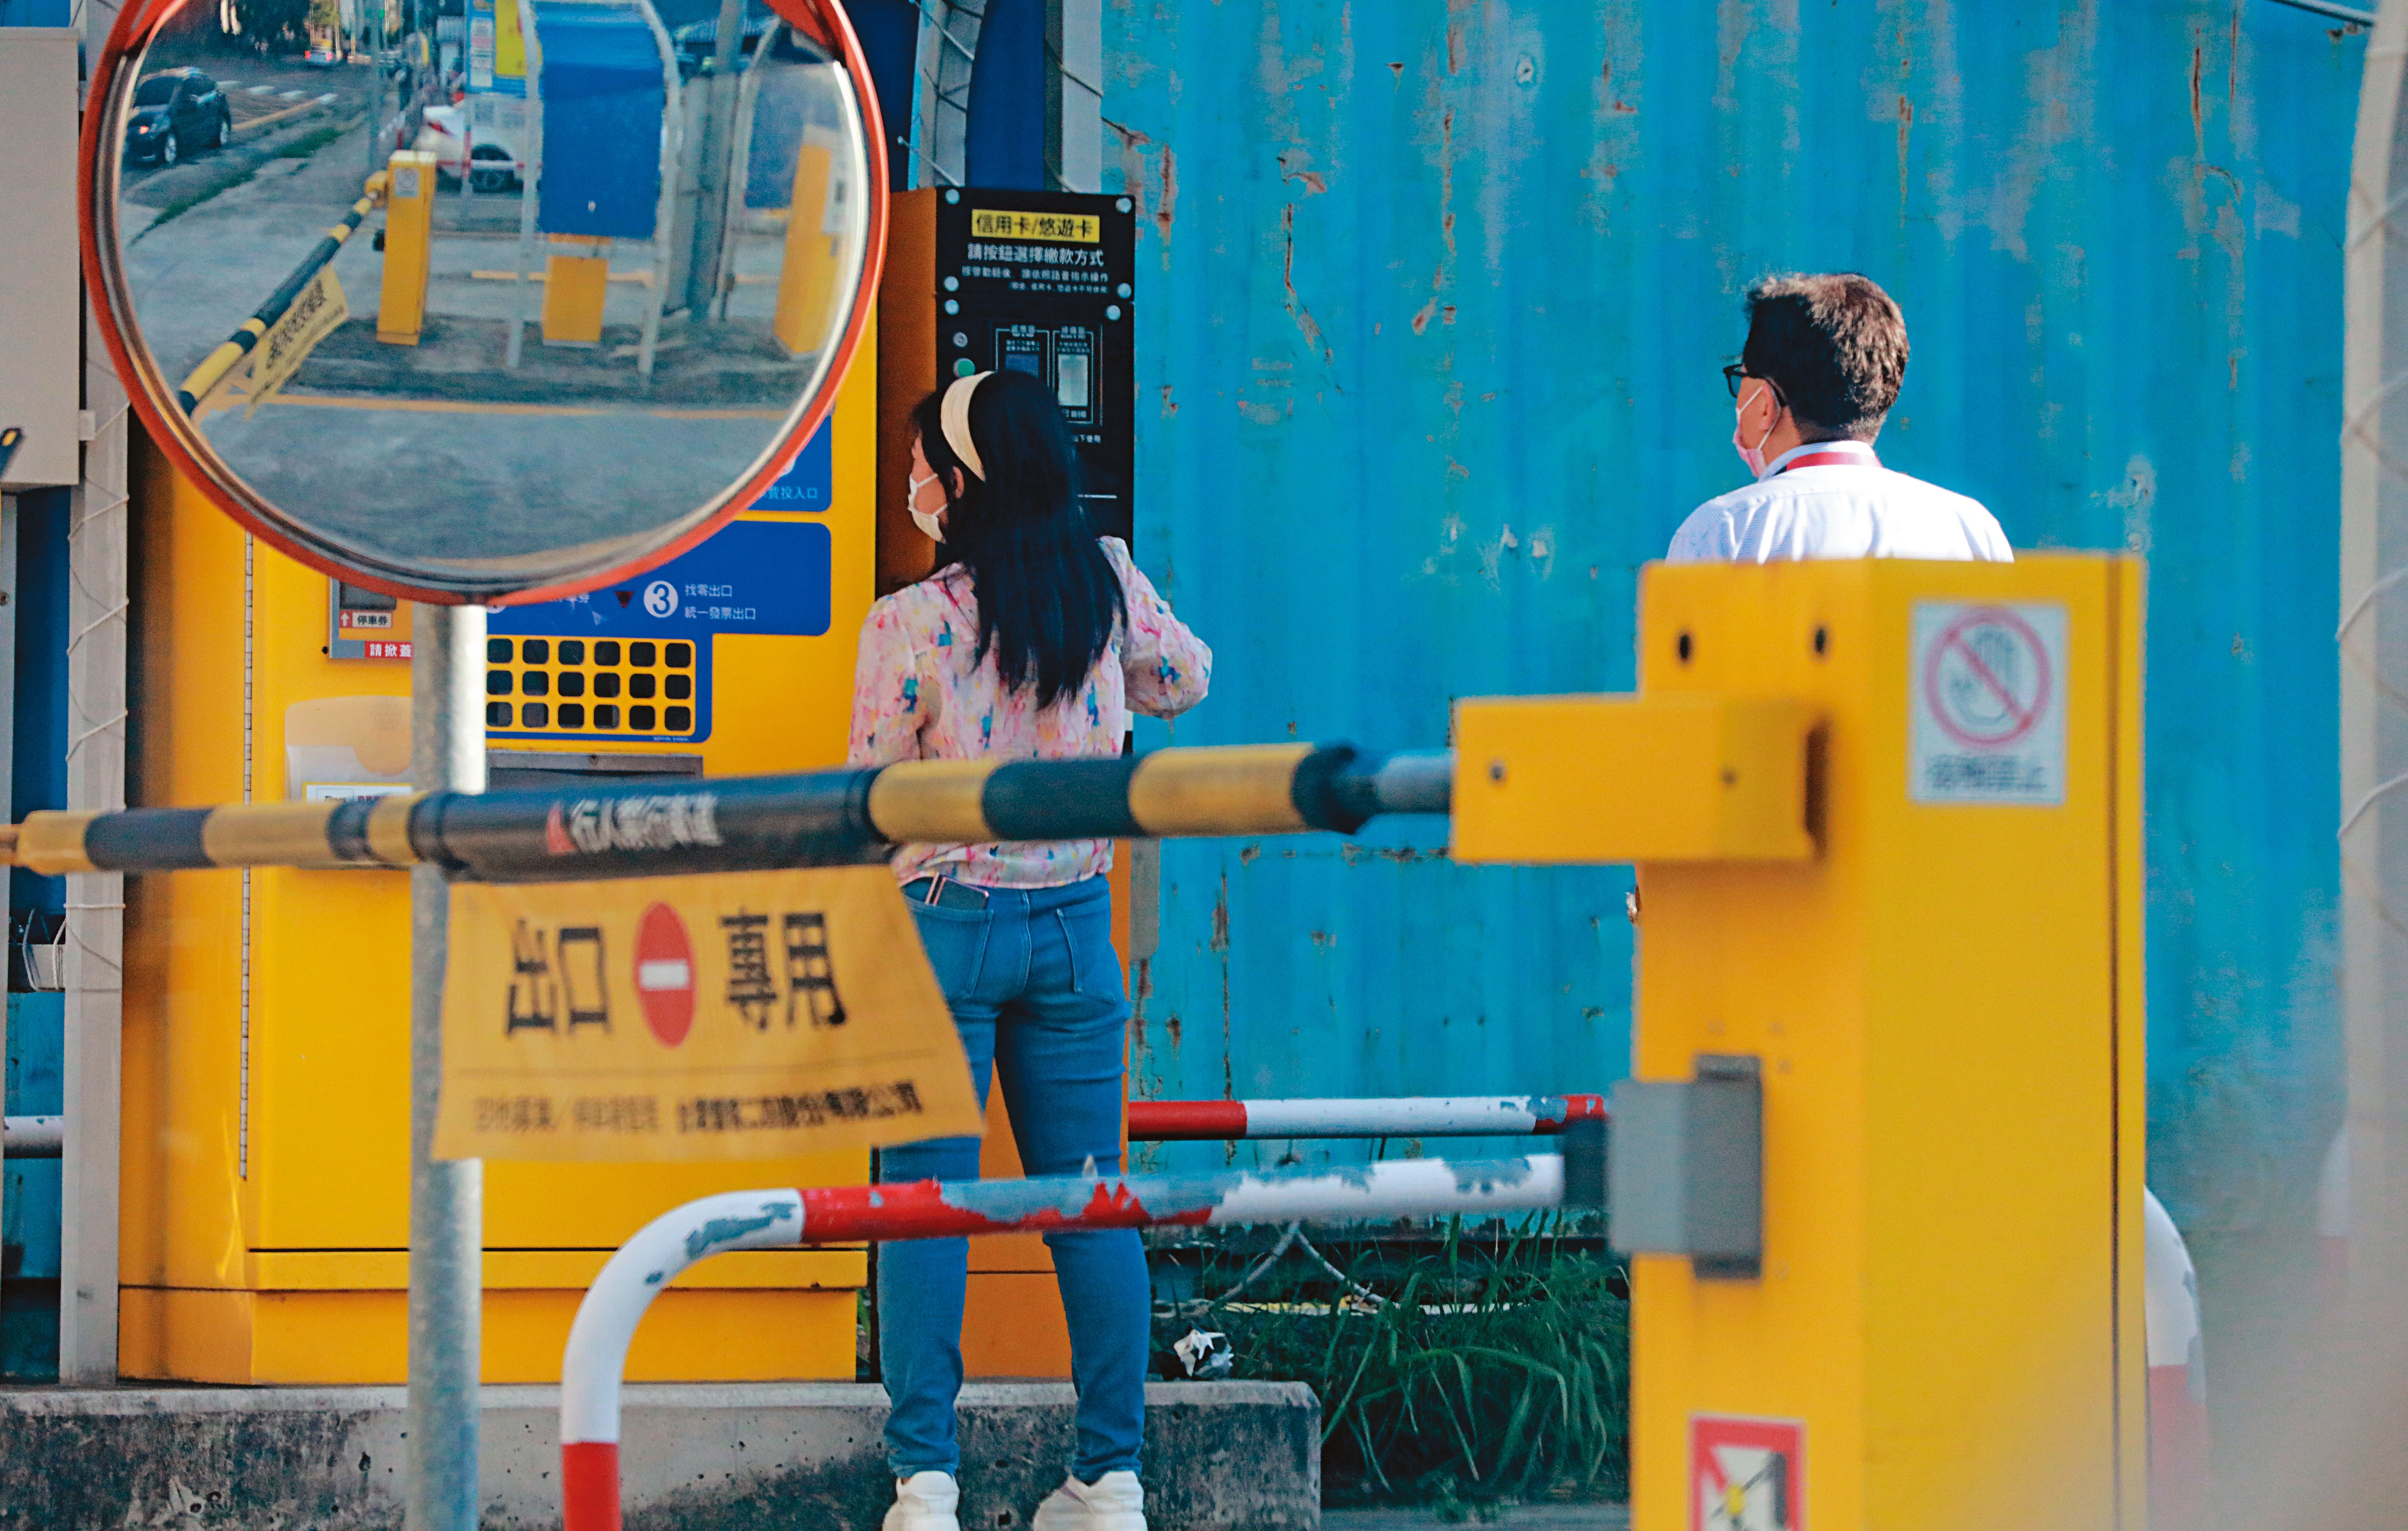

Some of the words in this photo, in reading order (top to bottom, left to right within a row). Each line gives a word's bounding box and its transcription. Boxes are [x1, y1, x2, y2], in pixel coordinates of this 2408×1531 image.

[976, 213, 1093, 238] 信用卡/悠遊卡
[967, 242, 1104, 267] 請按鈕選擇繳款方式
[685, 584, 732, 597] 找零出口
[685, 606, 756, 619] 統一發票出口
[370, 643, 412, 657] 請掀蓋
[504, 916, 614, 1038] 出口
[719, 905, 845, 1033] 專用
